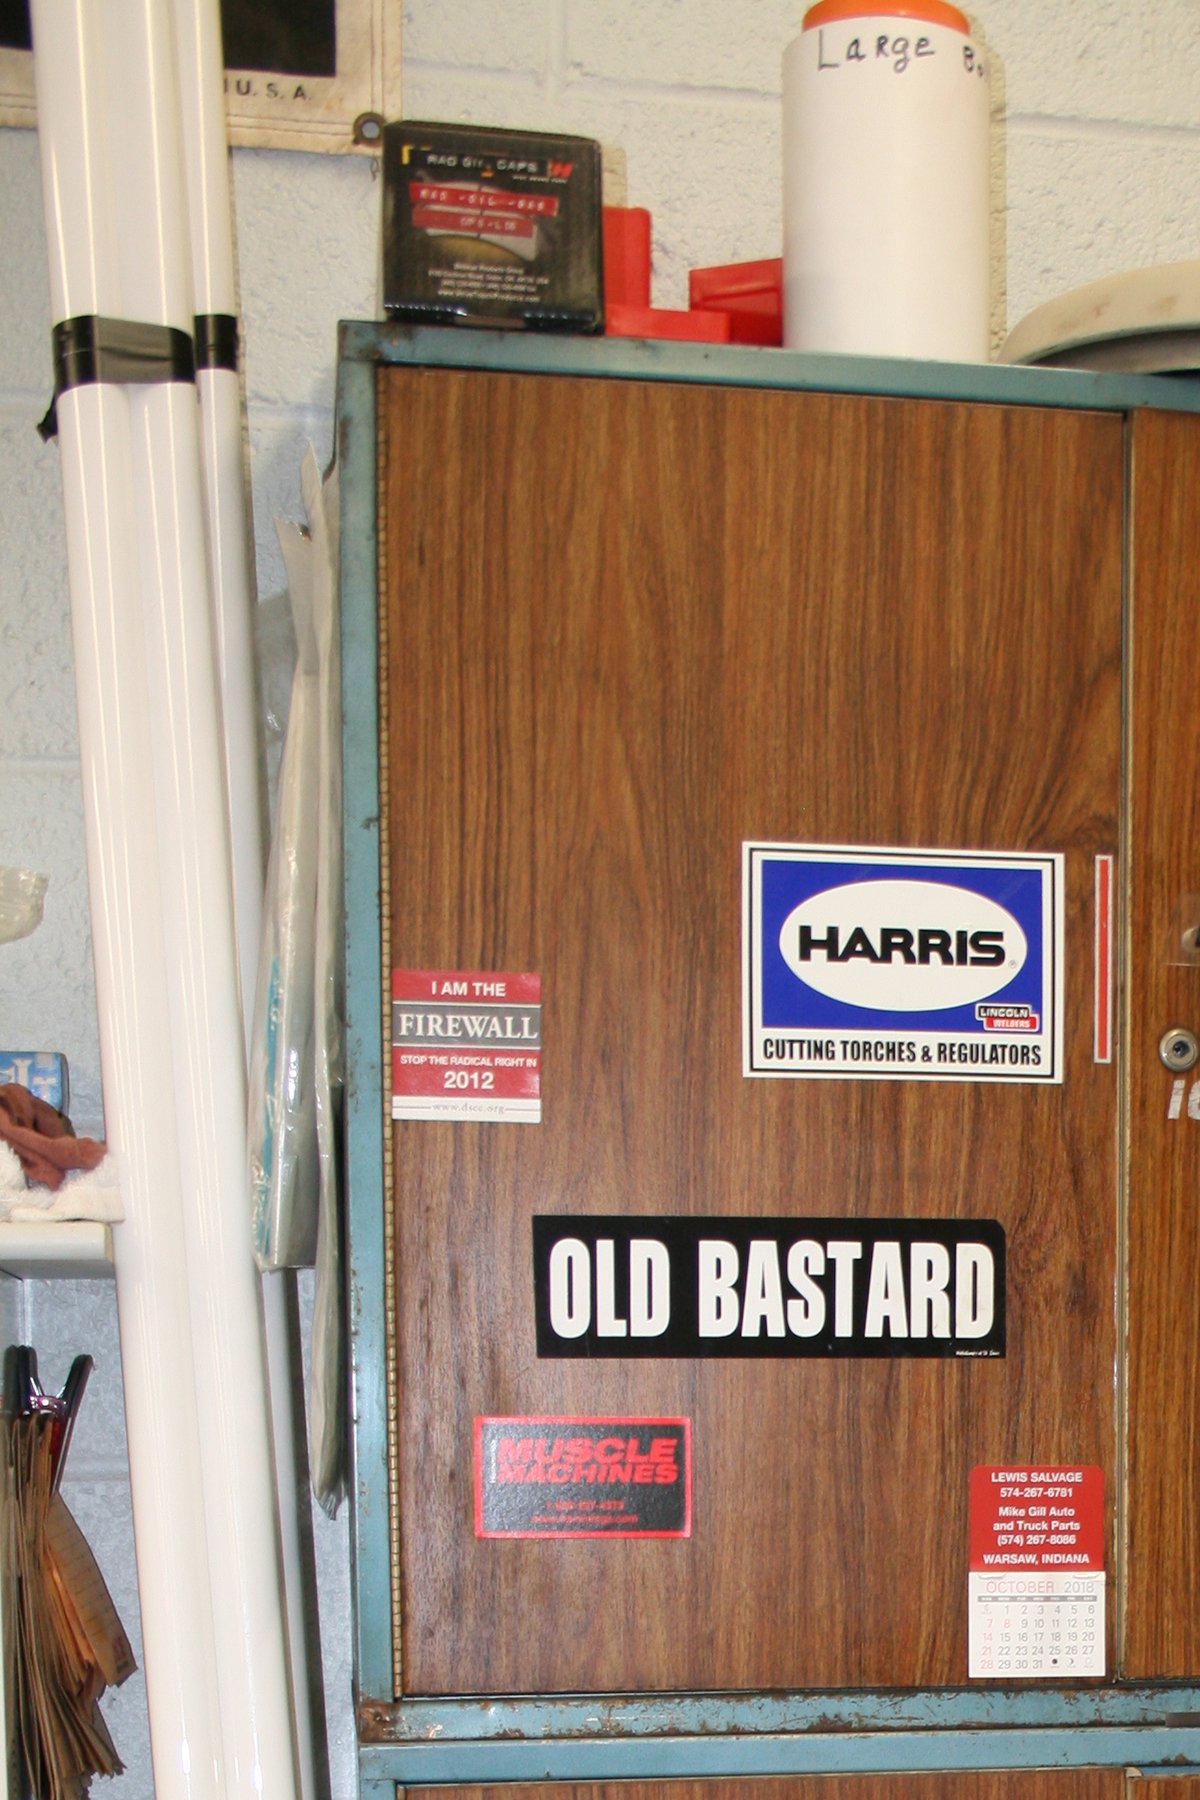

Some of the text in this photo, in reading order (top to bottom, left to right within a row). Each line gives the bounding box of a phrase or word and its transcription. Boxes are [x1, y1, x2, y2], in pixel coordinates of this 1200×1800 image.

[798, 924, 1006, 967] HARRIS
[431, 981, 507, 997] I AM THE
[980, 1007, 1029, 1018] LINCOLN
[398, 1013, 539, 1039] FIREWALL
[992, 1019, 1031, 1028] WELDERS
[763, 1038, 1042, 1066] CUTTING TORCHES & REGULATORS
[400, 1055, 537, 1068] STOP THE RADICAL RIGHT IN
[443, 1071, 495, 1090] 2012
[550, 1237, 995, 1339] OLD BASTARD
[497, 1437, 678, 1463] MUSCLE
[496, 1462, 679, 1484] MACHINES
[991, 1472, 1083, 1482] LEWIS SALVAGE
[1000, 1487, 1073, 1497] 574-267-6781
[998, 1506, 1075, 1517] Mike Gill Auto
[993, 1520, 1080, 1531] and Truck Parts
[997, 1534, 1024, 1546] (574)
[983, 1553, 1090, 1565] WARSAW, INDIANA
[986, 1581, 1095, 1593] OCTOBER 2018
[1004, 1605, 1095, 1614] 1 2 3 4 5 6
[987, 1619, 1095, 1628] 7 8 9 10 11 12 13
[983, 1632, 1095, 1642] 14 15 16 17 18 19 20
[982, 1646, 1095, 1656] 21 22 23 24 25 26 27
[981, 1660, 1042, 1670] 28 29 30 31
